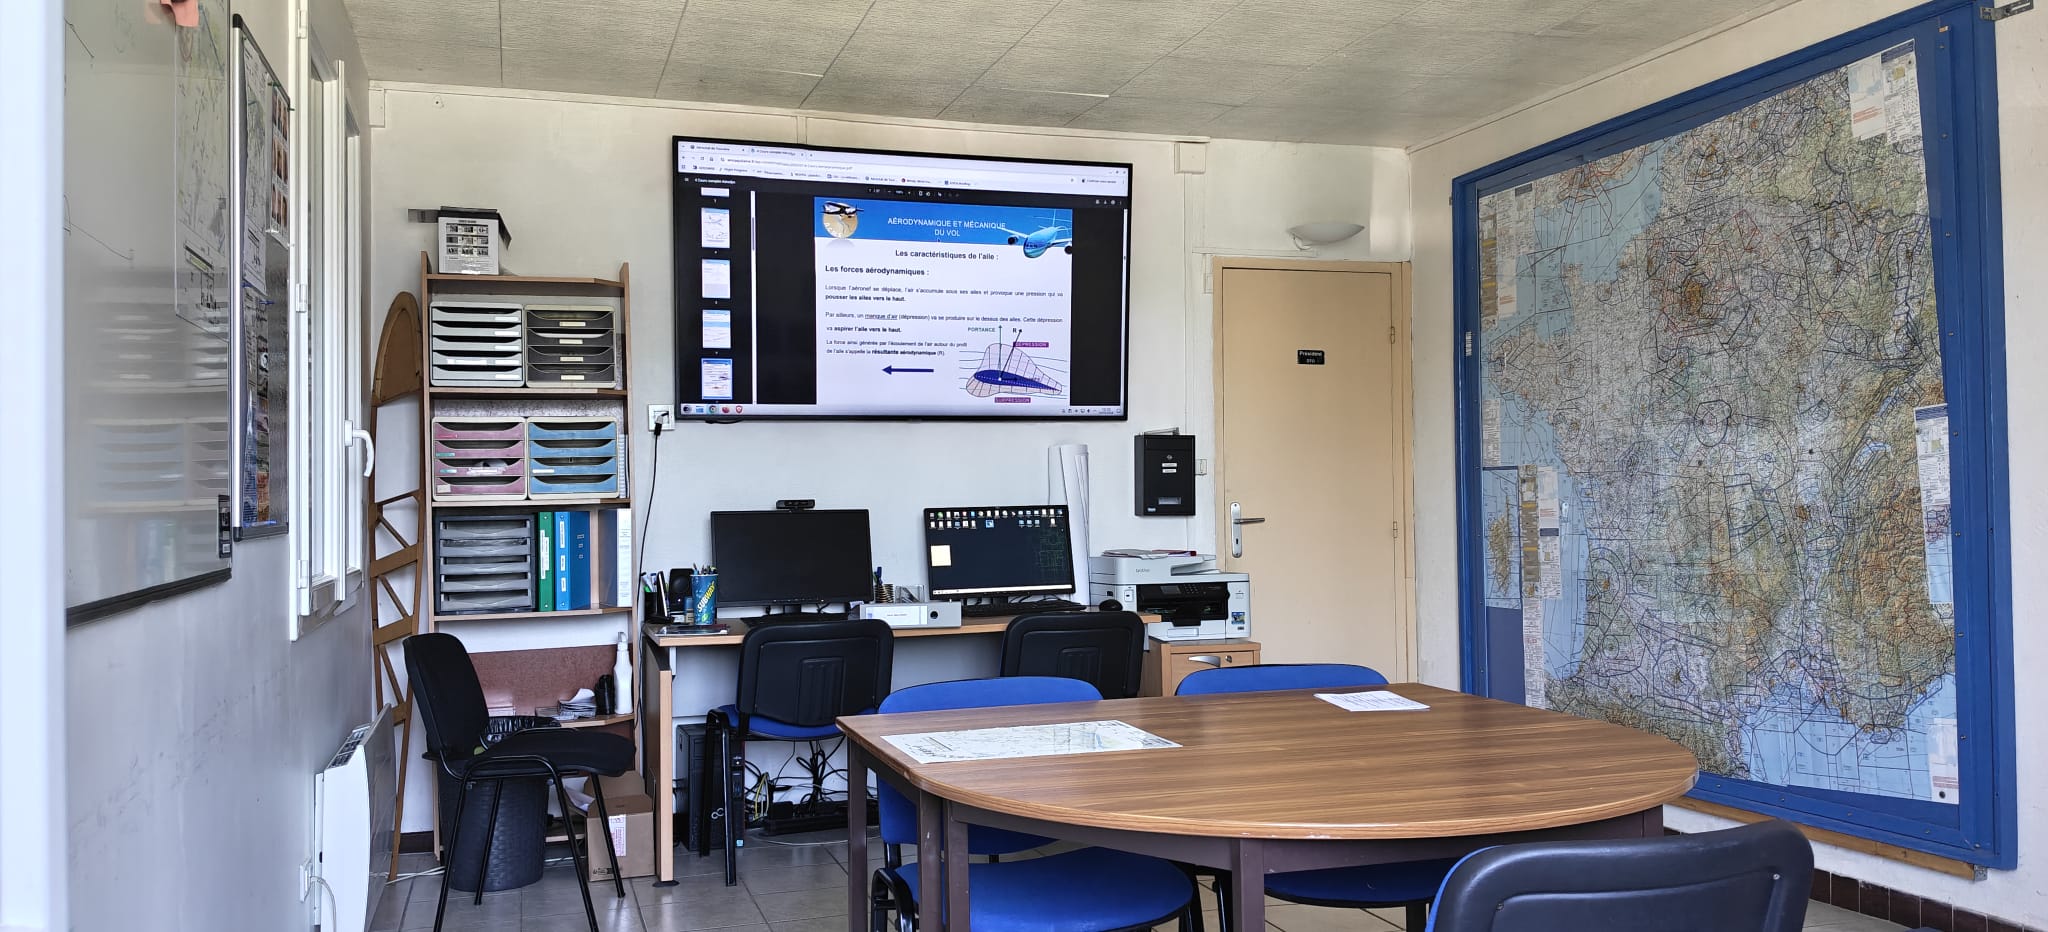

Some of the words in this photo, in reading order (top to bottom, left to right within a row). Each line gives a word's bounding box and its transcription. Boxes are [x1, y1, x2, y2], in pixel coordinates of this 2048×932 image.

[887, 217, 951, 228] AÉRODYNAMIQUE
[963, 220, 1006, 229] MÉCANIQUE
[934, 229, 945, 237] DU
[946, 229, 961, 237] VOL
[895, 249, 908, 257] Les
[910, 249, 967, 261] caractéristiques
[968, 252, 977, 260] de
[979, 252, 995, 260] l'aile
[825, 265, 839, 273] Les
[840, 265, 864, 273] forces
[865, 266, 925, 277] aérodynamiques
[898, 313, 930, 321] (dépression)
[899, 349, 936, 357] aérodynamique
[697, 580, 715, 613] SUBWAY
